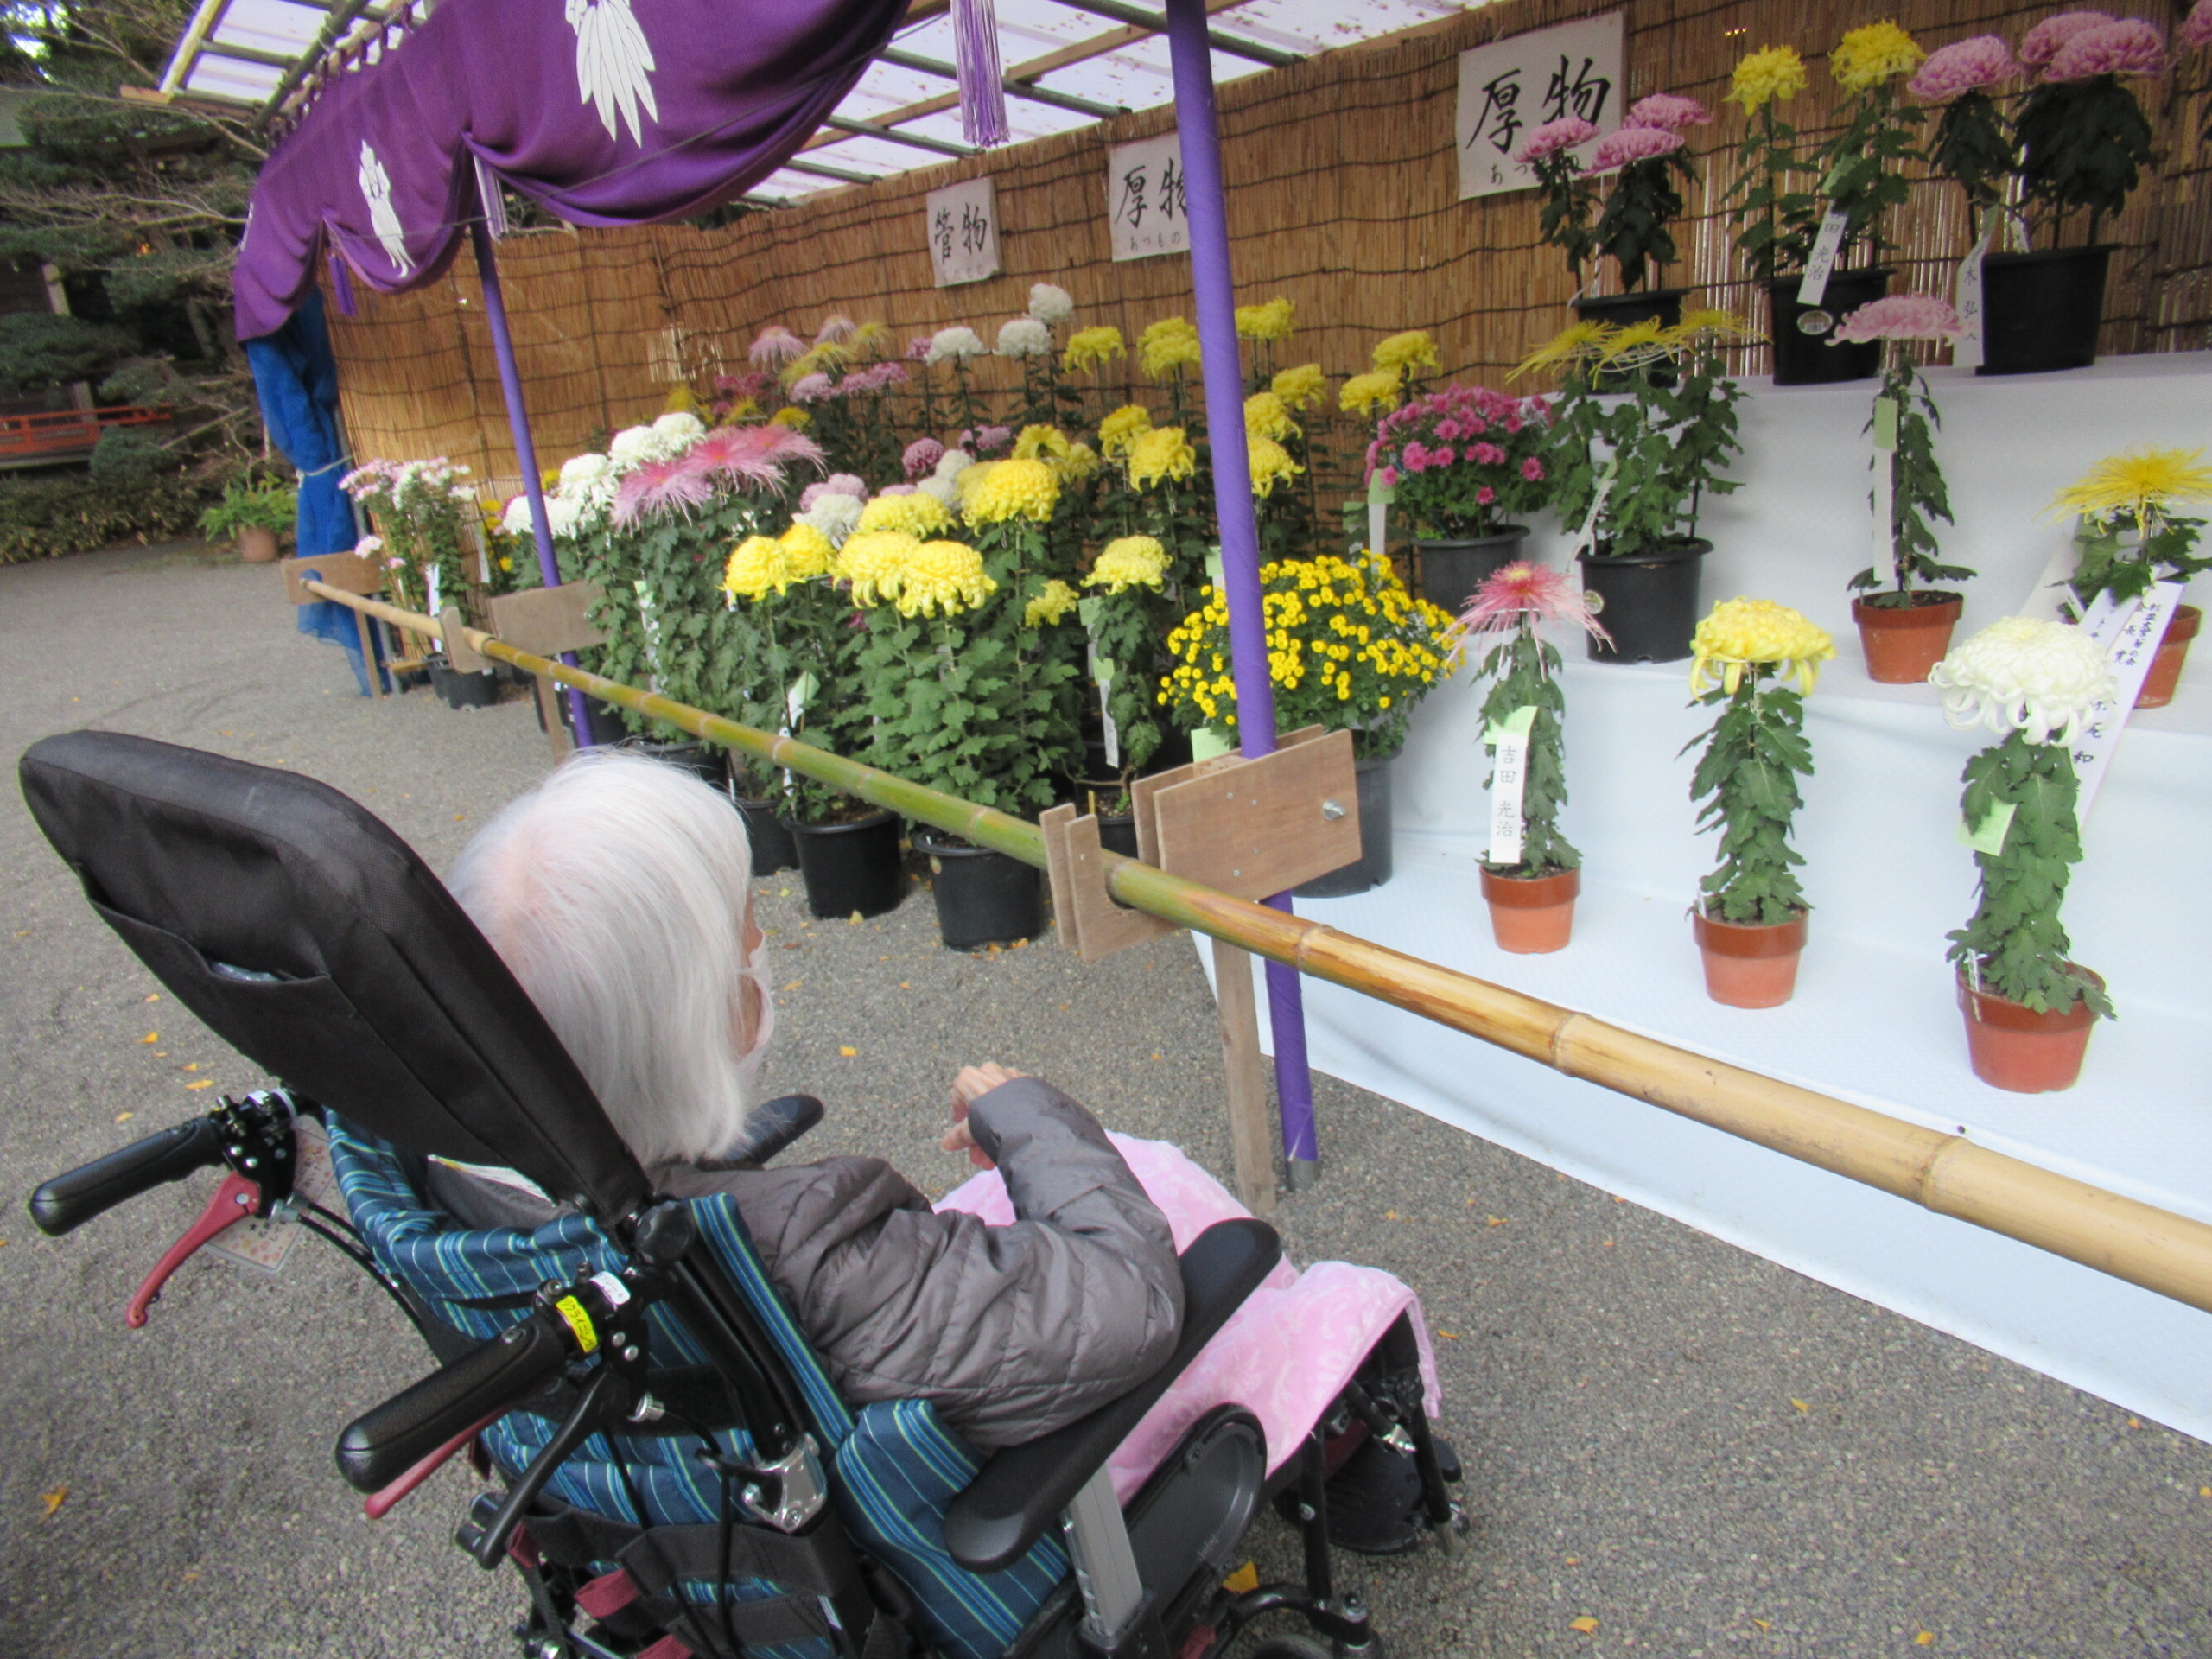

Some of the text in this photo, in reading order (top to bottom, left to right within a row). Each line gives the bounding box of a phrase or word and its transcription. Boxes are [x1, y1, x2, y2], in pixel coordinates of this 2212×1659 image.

[1466, 54, 1611, 155] 厚物
[934, 202, 987, 265] 管物
[1807, 213, 1840, 281] 田光治
